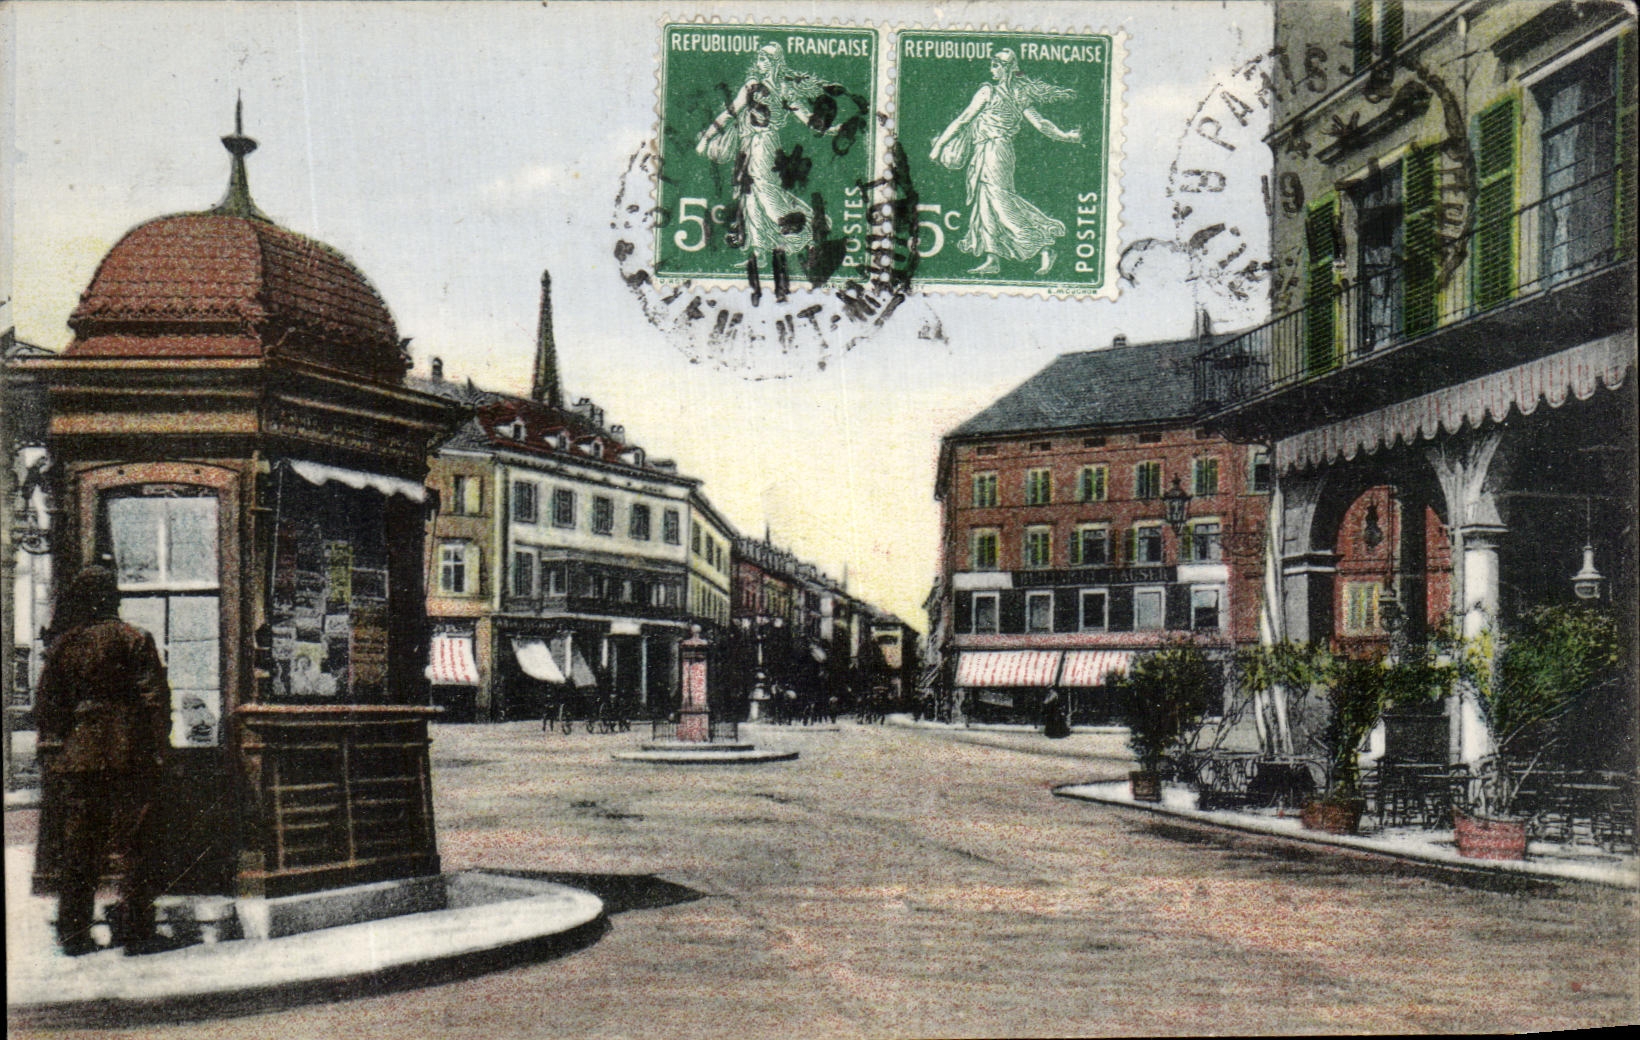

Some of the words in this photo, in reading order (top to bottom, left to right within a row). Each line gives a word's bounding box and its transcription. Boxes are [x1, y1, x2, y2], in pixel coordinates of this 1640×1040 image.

[670, 32, 762, 54] REPUBLIQUE
[786, 36, 869, 58] FRANÇAISE
[904, 41, 994, 62] REPUBLIQUE
[1020, 42, 1102, 65] FRANÇAISE
[843, 185, 863, 268] POSTES
[1074, 190, 1096, 273] POSTES
